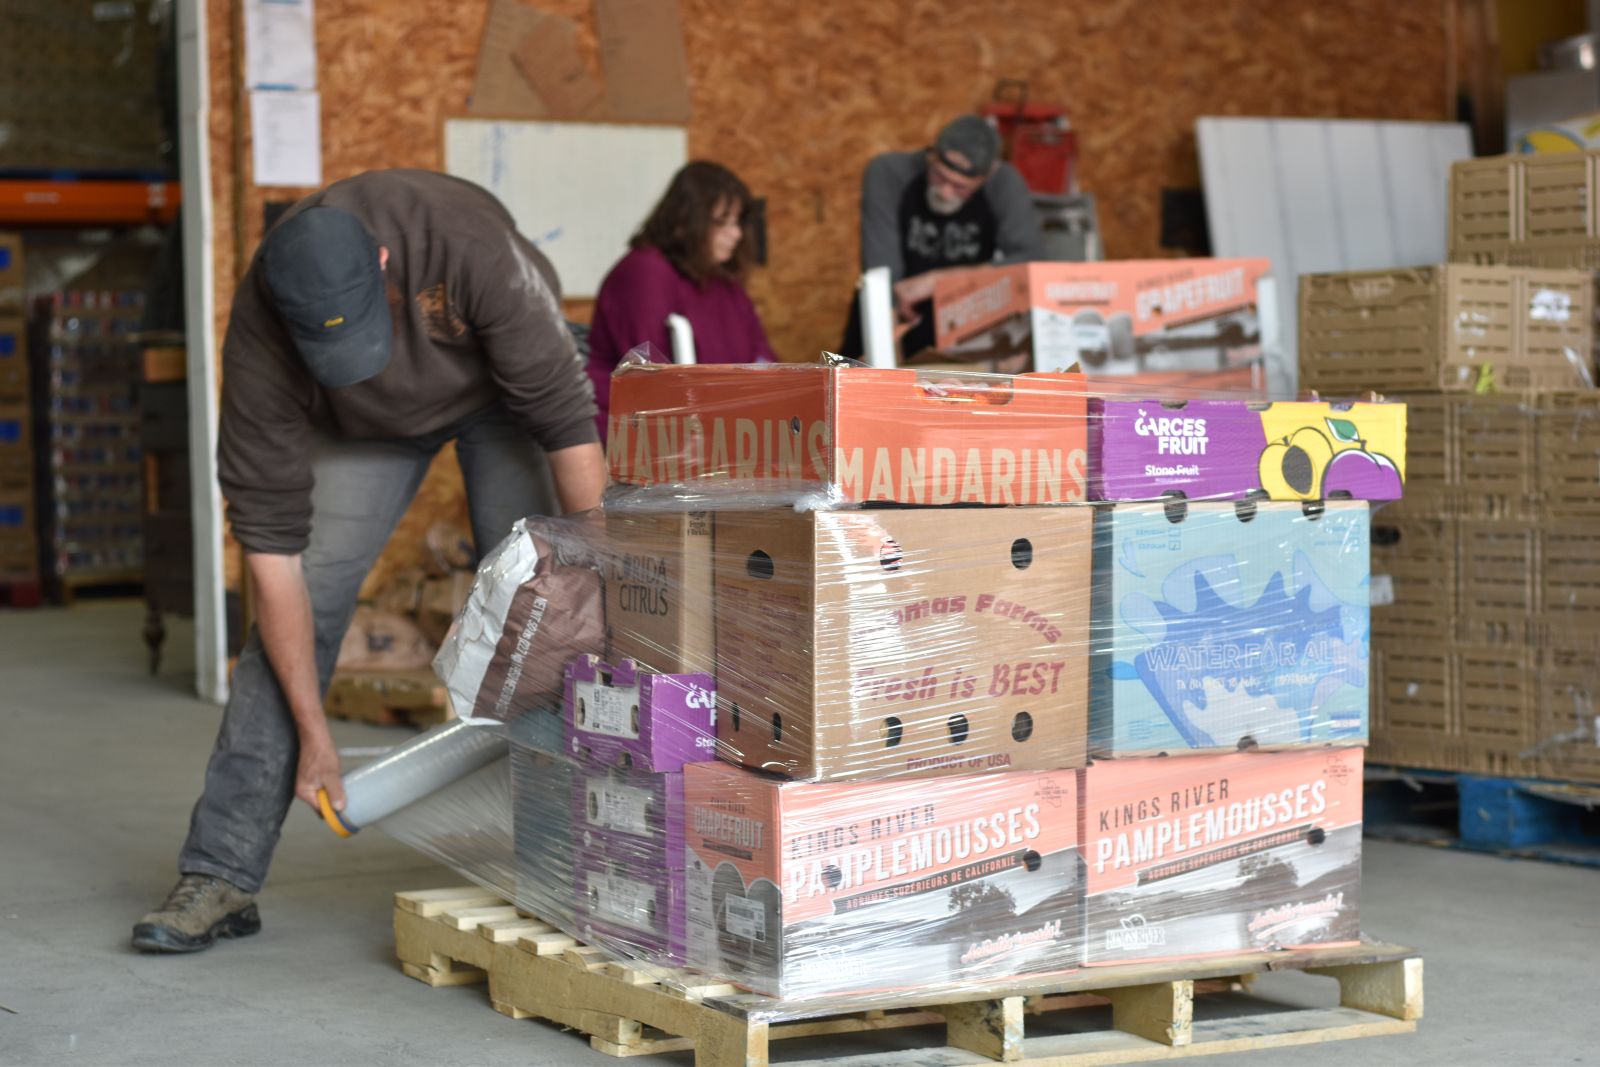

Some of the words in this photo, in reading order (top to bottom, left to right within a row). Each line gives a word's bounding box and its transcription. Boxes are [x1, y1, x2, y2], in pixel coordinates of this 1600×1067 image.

[1134, 412, 1207, 437] GARCES
[606, 414, 829, 486] MANDARINS
[1157, 436, 1209, 455] FRUIT
[837, 446, 1087, 505] MANDARINS
[1177, 464, 1200, 476] Fruit
[619, 584, 669, 616] CITRUS
[975, 593, 1062, 643] Farms
[1144, 644, 1240, 671] WATER
[1301, 640, 1346, 666] ALL
[950, 667, 976, 698] is
[989, 661, 1065, 697] BEST
[906, 755, 965, 770] PRODUCT
[968, 756, 983, 768] OF
[987, 754, 1011, 767] USA
[1099, 797, 1161, 832] KINGS
[1171, 779, 1230, 813] RIVER
[694, 806, 764, 849] GRAPEFRUIT
[791, 823, 860, 860] KINGS
[870, 804, 936, 840] RIVER
[1096, 780, 1327, 874] PAMPLEMOUSSES
[788, 802, 1041, 901] PAMPLEMOUSSES
[951, 871, 962, 882] DE
[966, 855, 1017, 878] CALIFORNIE
